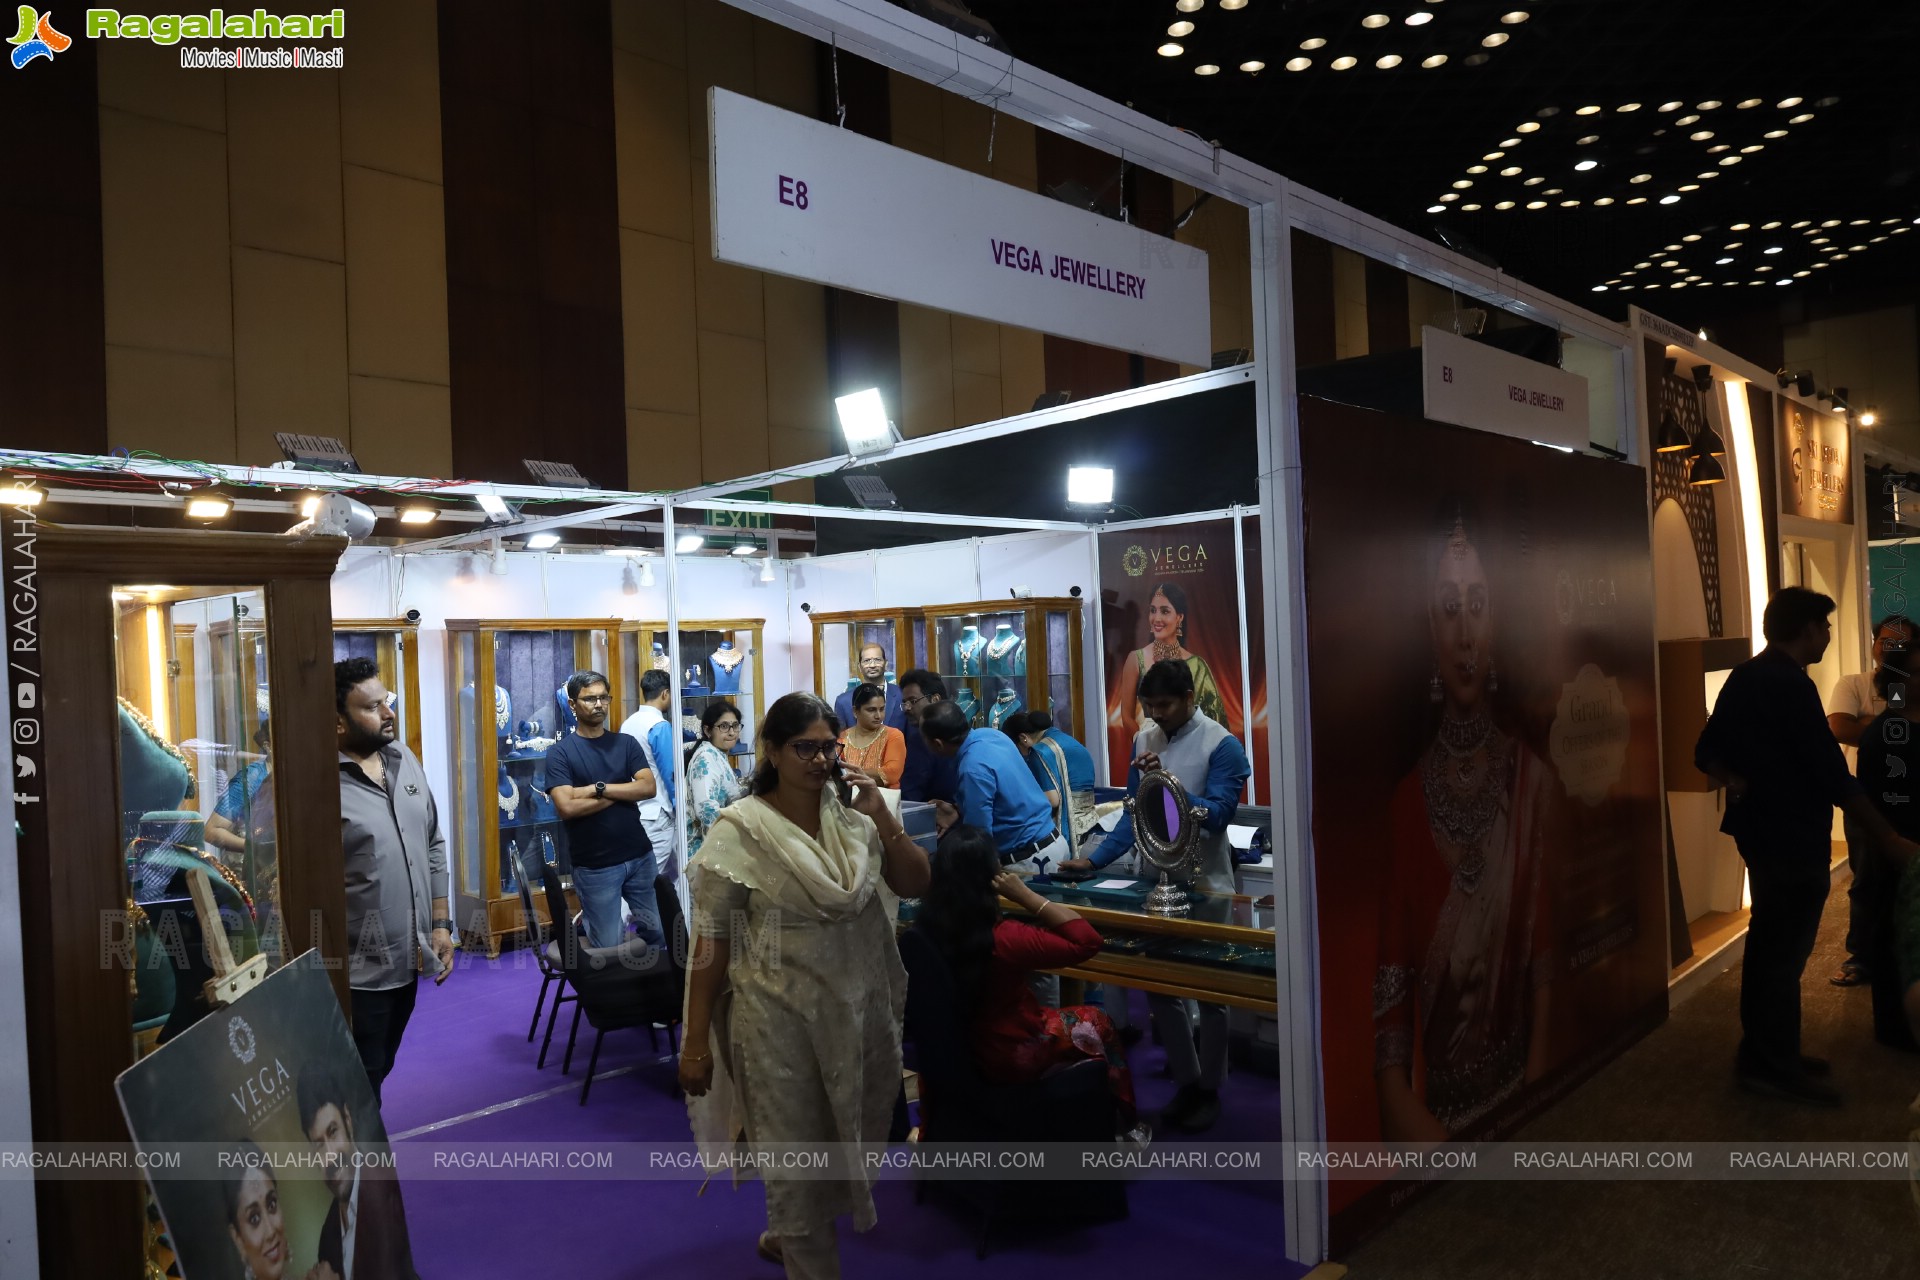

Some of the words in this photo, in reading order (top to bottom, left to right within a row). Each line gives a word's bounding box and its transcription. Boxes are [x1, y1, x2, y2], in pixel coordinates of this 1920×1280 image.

[778, 174, 809, 211] E8
[991, 238, 1044, 276] VEGA
[1050, 255, 1147, 300] JEWELLERY
[1442, 365, 1453, 384] E8
[1508, 384, 1528, 405] VEGA
[1529, 391, 1565, 412] JEWELLERY
[711, 508, 766, 529] EXIT
[1150, 543, 1208, 565] VEGA
[1576, 575, 1617, 606] VEGA
[231, 1057, 290, 1115] VEGA
